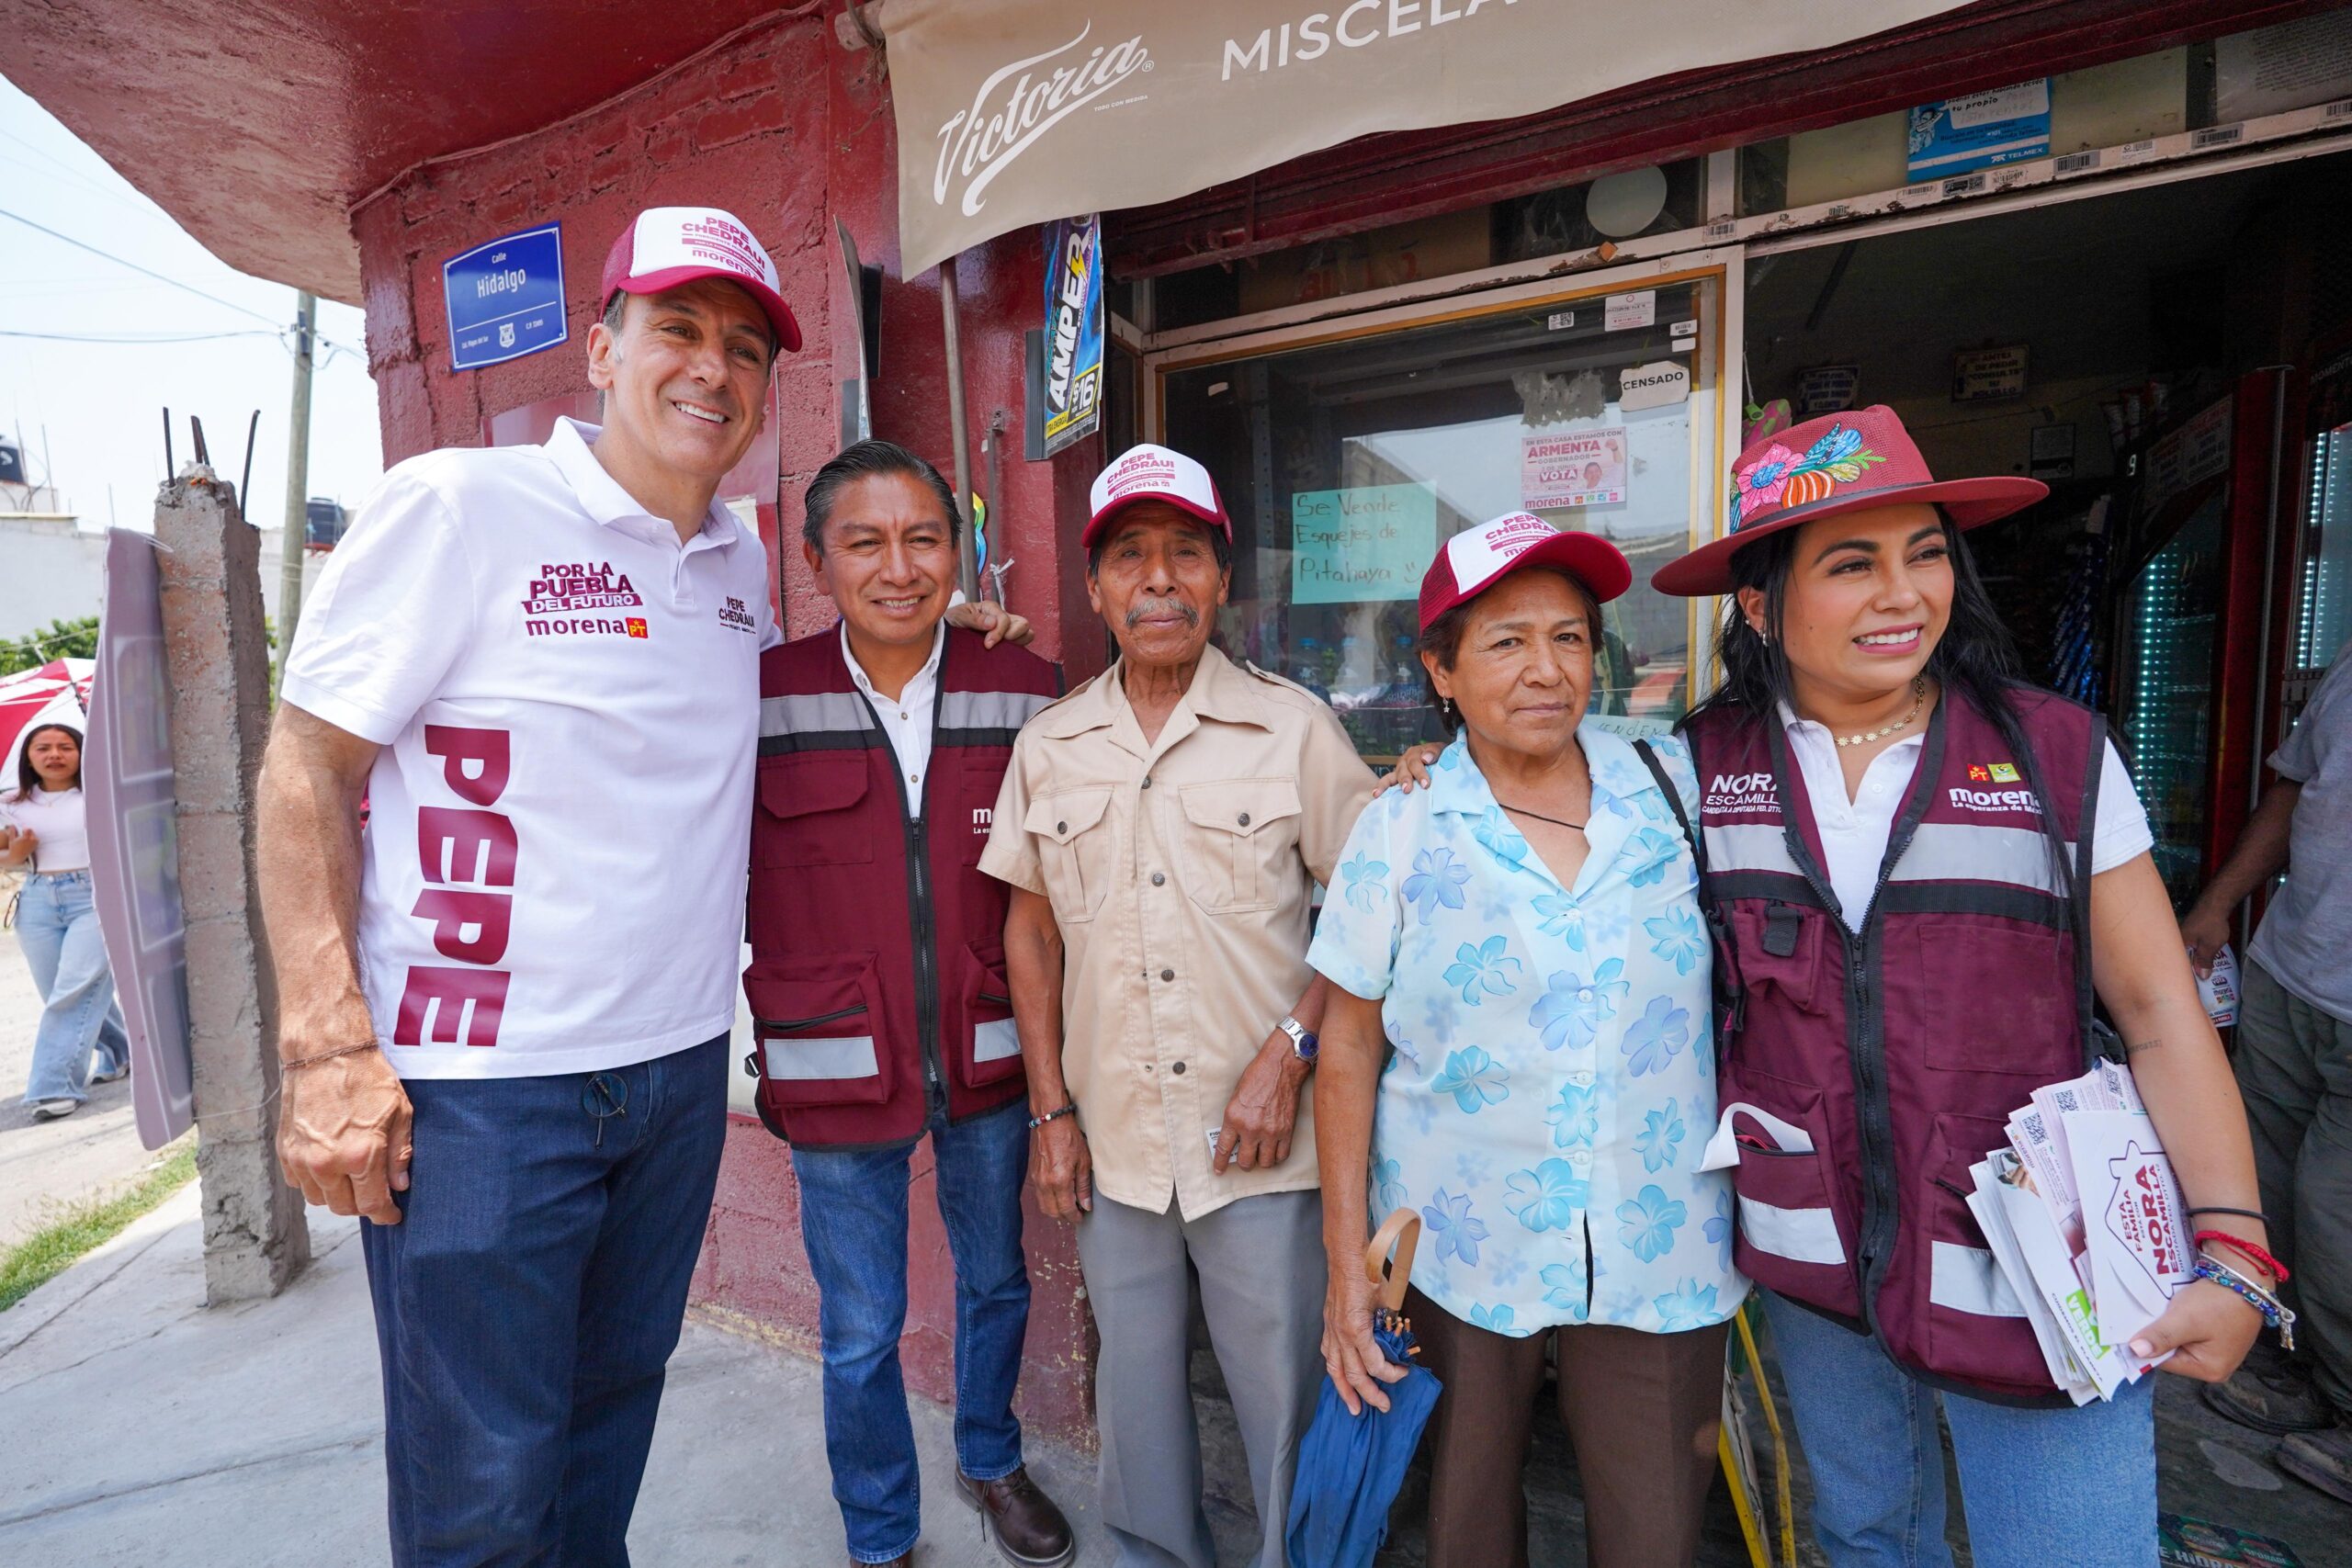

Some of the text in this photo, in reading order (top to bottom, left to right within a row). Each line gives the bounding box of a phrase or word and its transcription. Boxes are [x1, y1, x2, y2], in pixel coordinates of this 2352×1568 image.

[1125, 95, 1148, 105] MEDIDA
[1965, 96, 1998, 110] propio
[933, 17, 1148, 217] Victoria
[2007, 147, 2043, 159] TELMEX
[706, 217, 749, 244] PEPE
[682, 223, 765, 270] CHEDRAUI
[492, 253, 507, 264] Calle
[692, 250, 752, 279] morena
[477, 268, 526, 299] Hidalgo
[1049, 227, 1093, 410] AMPER
[1623, 371, 1684, 390] CENSADO
[1072, 372, 1094, 411] $16
[1574, 432, 1606, 441] ESTAMOS
[1528, 440, 1601, 458] ARMENTA
[1538, 454, 1591, 465] GOBERNADOR
[1121, 453, 1155, 468] PEPE
[1107, 459, 1175, 484] CHEDRAUI
[1541, 469, 1577, 481] VOTA
[1113, 480, 1160, 502] morena
[1296, 492, 1401, 518] Se Vende
[1525, 497, 1570, 509] morena
[1295, 523, 1398, 550] Esquejes de
[541, 561, 615, 579] POR LA
[1300, 557, 1392, 584] Pitahaya
[529, 574, 635, 600] PUEBLA
[531, 594, 635, 614] DEL FUTURO
[726, 596, 746, 613] PEPE
[526, 618, 628, 637] morena
[718, 607, 755, 628] CHEDRAUI
[629, 623, 647, 637] PT
[1710, 773, 1778, 795] NOR
[1970, 771, 1987, 781] PT
[1706, 793, 1781, 806] ESCAMILL
[1965, 803, 2008, 812] esperanza
[393, 724, 518, 1046] PEPE
[2119, 1201, 2132, 1240] ESTA
[2123, 1190, 2143, 1252] FAMILIA
[2135, 1165, 2170, 1275] NORA
[2149, 1164, 2180, 1273] ESCAMILLA
[2067, 1294, 2104, 1359] VERDE
